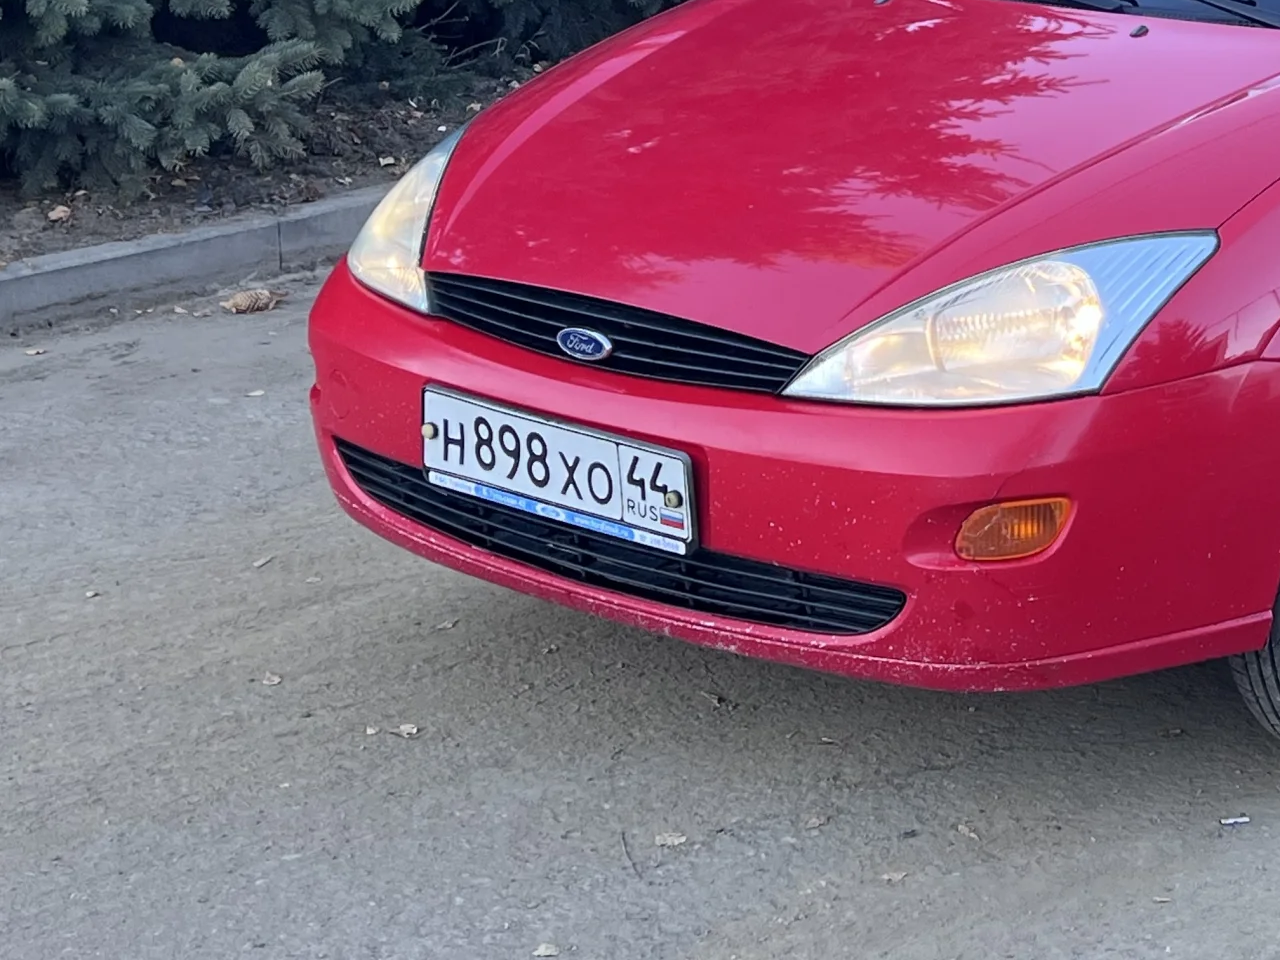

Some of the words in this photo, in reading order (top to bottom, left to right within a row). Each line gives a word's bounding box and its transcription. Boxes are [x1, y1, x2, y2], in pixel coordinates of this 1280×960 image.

[567, 334, 595, 354] Ford
[627, 455, 668, 501] 44
[627, 498, 659, 522] RUS
